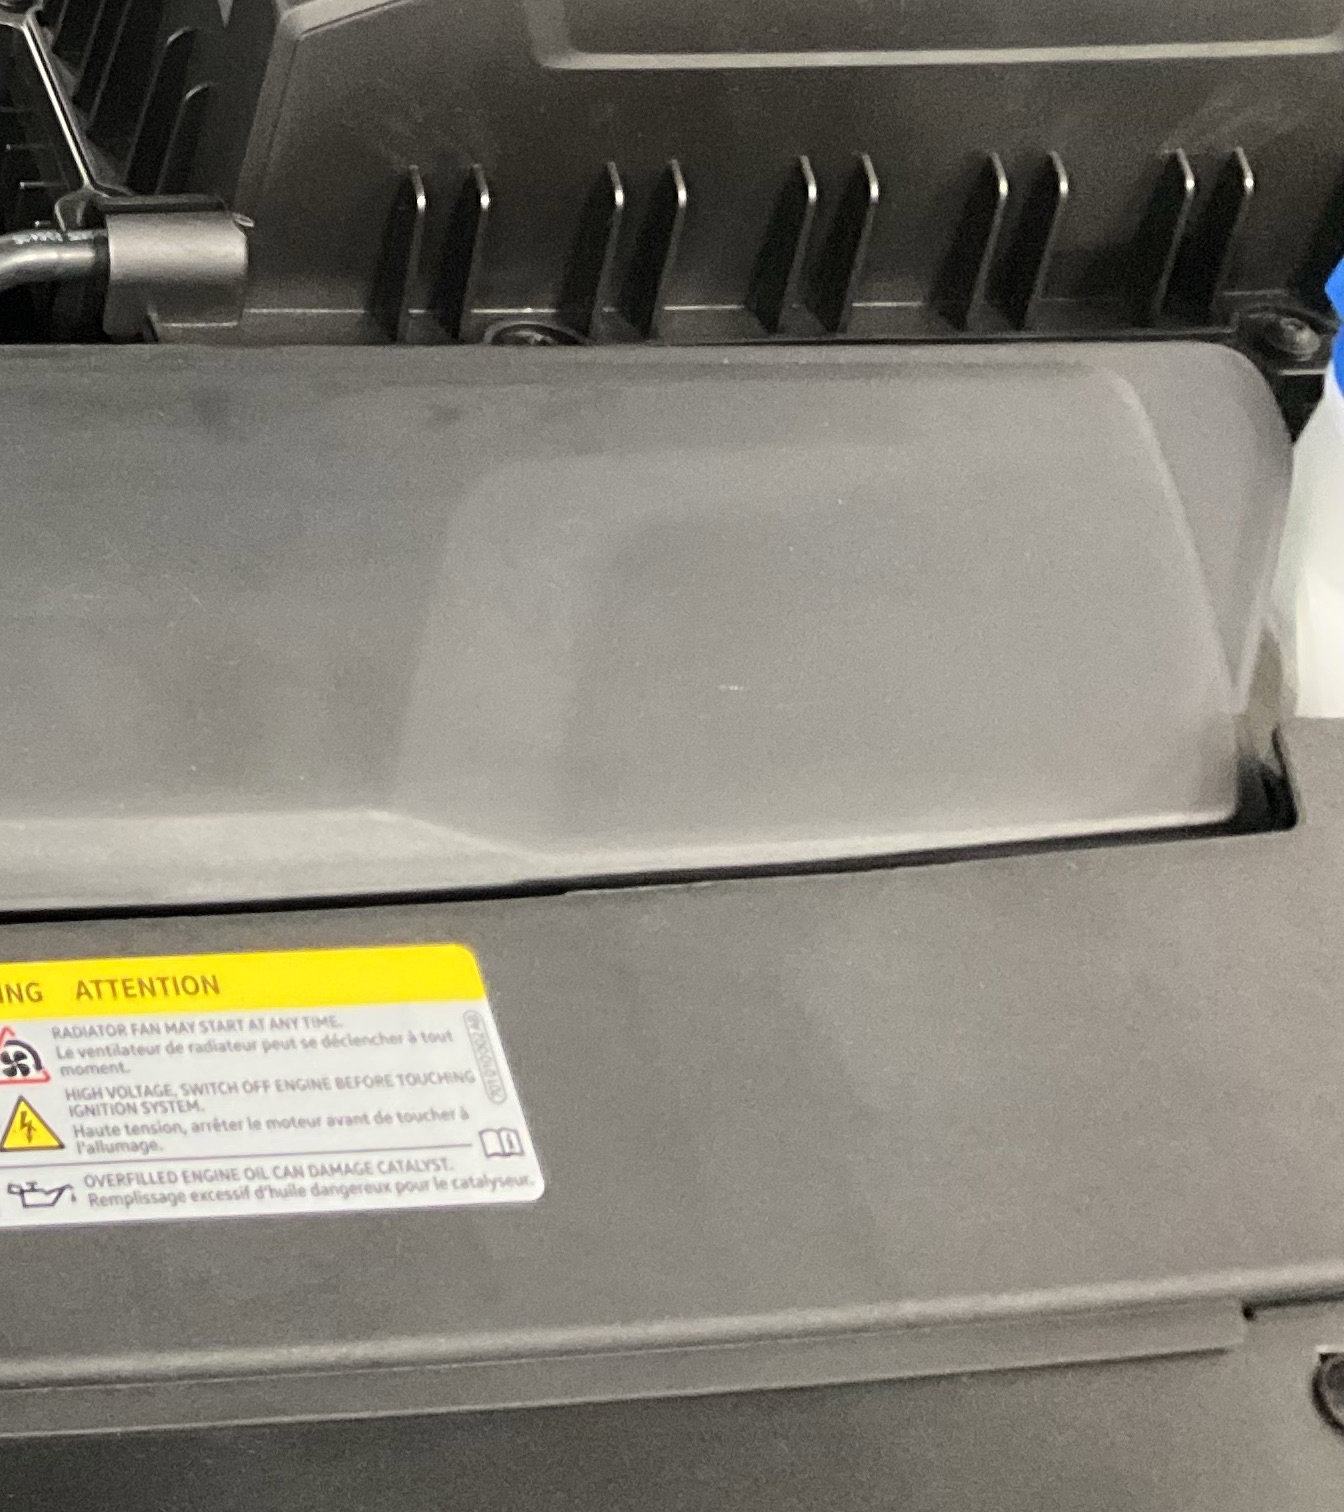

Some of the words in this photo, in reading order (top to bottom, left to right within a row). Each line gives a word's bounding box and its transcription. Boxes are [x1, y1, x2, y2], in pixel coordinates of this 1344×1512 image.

[75, 975, 221, 1001] ATTENTION
[51, 1024, 127, 1039] RADIATOR
[130, 1022, 161, 1036] FAN
[165, 1021, 195, 1034] MAY
[199, 1019, 245, 1033] START
[248, 1018, 266, 1031] AT
[270, 1016, 303, 1031] ANY
[302, 1016, 343, 1029] TIME.
[56, 1046, 74, 1060] Le
[77, 1042, 161, 1059] ventilateur
[165, 1041, 184, 1054] de
[188, 1038, 257, 1053] radiateur
[263, 1036, 297, 1053] peut
[300, 1037, 320, 1049] se
[421, 1029, 454, 1043] tout
[60, 1062, 131, 1077] moment.
[65, 1086, 103, 1101] HIGH
[181, 1080, 239, 1096] SWITCH
[242, 1079, 270, 1093] OFF
[275, 1077, 331, 1093] ENGINE
[335, 1074, 393, 1091] BEFORE
[396, 1070, 476, 1087] TOUCHING
[69, 1102, 137, 1118] IGNITION
[141, 1100, 205, 1115] SYSTEM.
[73, 1123, 121, 1138] Haute
[124, 1121, 188, 1136] tension,
[266, 1114, 322, 1130] moteur
[326, 1113, 370, 1127] avant
[374, 1110, 394, 1124] de
[396, 1107, 456, 1123] toucher
[77, 1139, 163, 1155] l'allumage.
[84, 1170, 178, 1188] OVERFILLED
[181, 1167, 240, 1184] ENGINE
[243, 1166, 269, 1181] OIL
[272, 1165, 304, 1179] CAN
[308, 1161, 374, 1178] DAMAGE
[377, 1158, 454, 1175] CATALYST.
[88, 1190, 186, 1209] Remplissage
[190, 1186, 249, 1202] excessif
[254, 1183, 306, 1200] d'huile
[310, 1180, 391, 1199] dangereux
[395, 1179, 430, 1195] pour
[452, 1174, 534, 1192] catalyseur.
